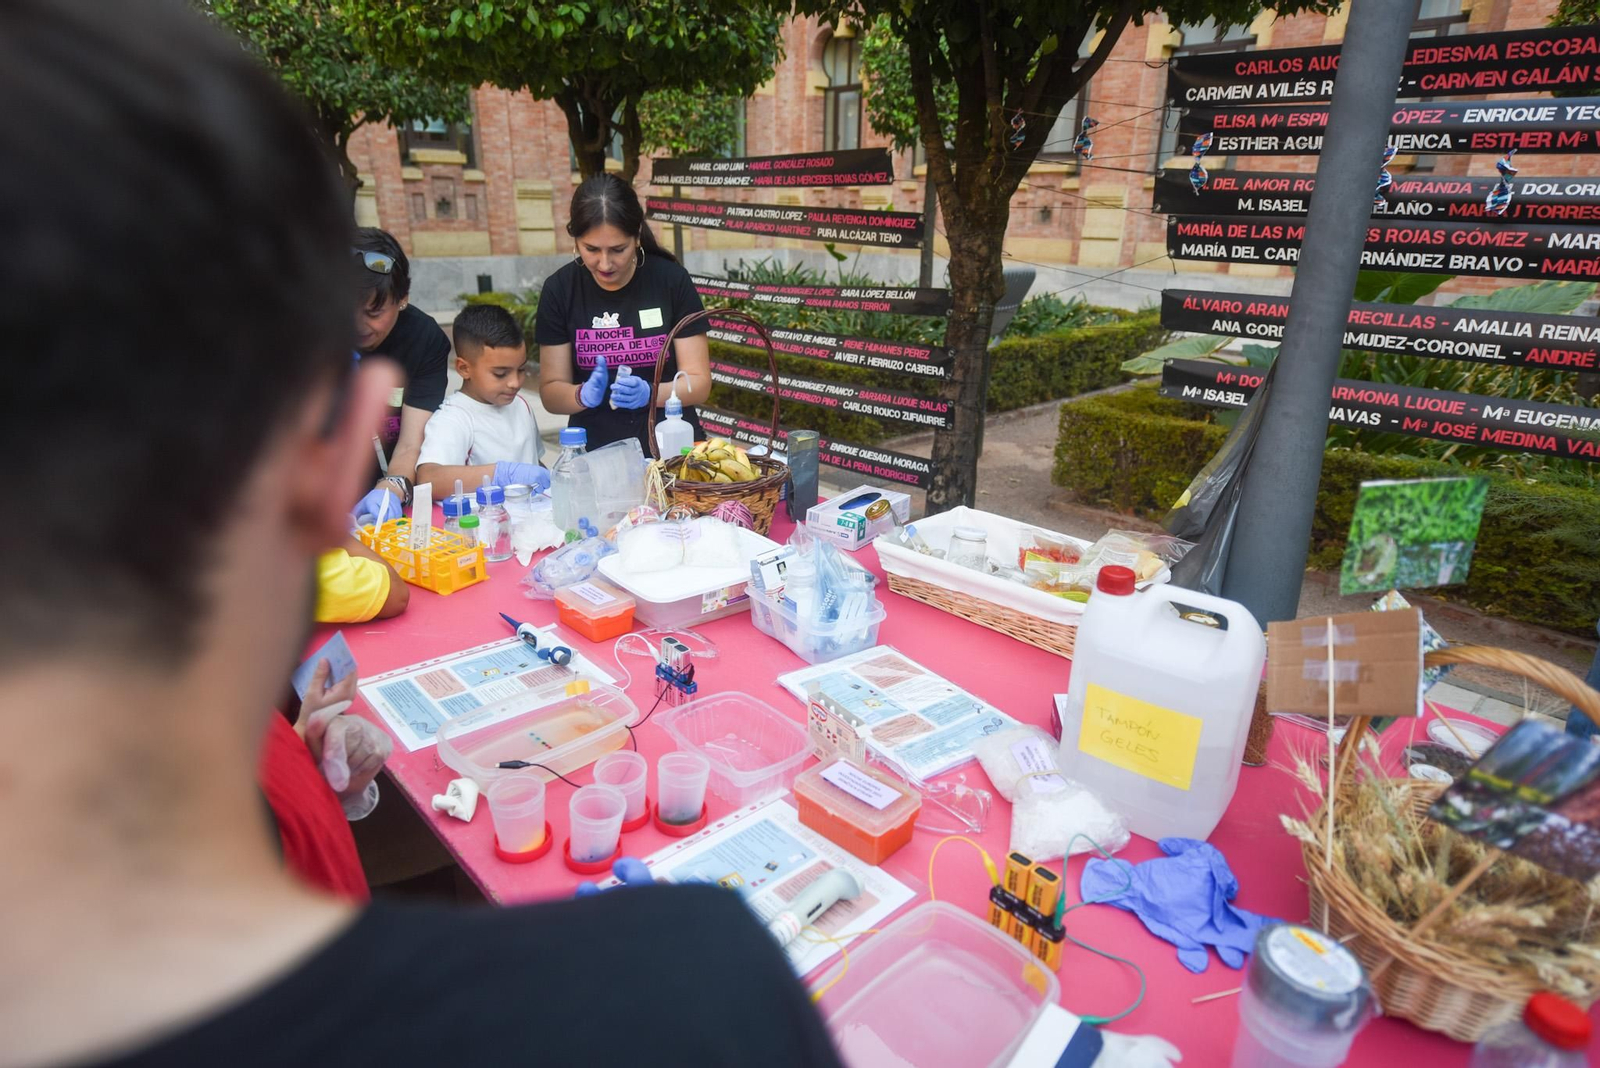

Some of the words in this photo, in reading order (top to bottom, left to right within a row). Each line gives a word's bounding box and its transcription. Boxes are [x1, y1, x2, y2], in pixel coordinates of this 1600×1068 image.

[1235, 58, 1303, 76] CARLOS
[1185, 84, 1253, 102] CARMEN
[1256, 78, 1317, 98] AVILÉS
[1420, 69, 1508, 91] CARMEN
[1511, 62, 1590, 86] GALÁN
[1213, 113, 1257, 129] ELISA
[1462, 106, 1558, 123] ENRIQUE
[1218, 136, 1279, 151] ESTHER
[1470, 131, 1553, 149] ESTHER
[689, 162, 712, 171] MANUEL
[713, 162, 729, 171] CANO
[729, 162, 745, 171] LUNA
[748, 162, 772, 171] MANUEL
[805, 157, 835, 168] ROSADO
[774, 175, 783, 185] DE
[783, 175, 796, 185] LAS
[796, 174, 833, 185] MERCEDES
[834, 173, 857, 184] ROJAS
[858, 171, 887, 183] GÓMEZ
[1213, 177, 1239, 191] DEL
[1243, 178, 1290, 192] AMOR
[1389, 181, 1473, 195] MIRANDA
[726, 206, 753, 218] PATRICIA
[754, 208, 780, 219] CASTRO
[807, 211, 831, 223] PAULA
[832, 213, 867, 226] REVENGA
[868, 214, 917, 229] DOMÍNGUEZ
[725, 218, 745, 229] PILAR
[745, 221, 775, 232] APARICIO
[817, 227, 838, 238] PURA
[838, 228, 877, 242] ALCÁZAR
[879, 232, 902, 243] TENO
[1177, 220, 1224, 237] MARÍA
[1227, 224, 1248, 238] DE
[1250, 225, 1283, 239] LAS
[1385, 228, 1446, 245] ROJAS
[1451, 227, 1529, 247] GÓMEZ
[1181, 241, 1227, 258] MARÍA
[1231, 245, 1260, 260] DEL
[1449, 254, 1523, 272] BRAVO
[804, 298, 831, 308] SUSANA
[832, 299, 859, 310] RAMOS
[841, 288, 860, 298] SARA
[861, 287, 885, 299] LÓPEZ
[885, 288, 917, 300] BELLÓN
[1182, 295, 1243, 314] ÁLVARO
[1453, 318, 1533, 338] AMALIA
[1211, 319, 1242, 334] ANA
[577, 342, 626, 353] EUROPEA
[628, 340, 643, 350] DE
[578, 331, 590, 340] LA
[595, 328, 631, 340] NOCHE
[771, 329, 801, 342] GUSTAVO
[801, 333, 813, 343] DE
[812, 334, 838, 347] MIGUEL
[843, 338, 865, 350] IRENE
[865, 341, 903, 356] HUMANES
[804, 345, 831, 359] GÓMEZ
[858, 354, 867, 365] F.
[867, 356, 904, 371] HERRUZO
[716, 362, 738, 375] TORRES
[825, 384, 854, 397] FRANCO
[892, 394, 918, 409] LUQUE
[918, 400, 948, 413] SALAS
[791, 390, 822, 404] HERRUZO
[821, 396, 838, 407] PINO
[843, 400, 873, 414] CARLOS
[873, 405, 901, 419] ROUCO
[1404, 395, 1466, 416] LUQUE
[716, 414, 735, 426] LUQUE
[829, 442, 859, 457] ENRIQUE
[892, 456, 930, 474] MORAGA
[1431, 421, 1479, 440] JOSÉ
[1480, 427, 1558, 451] MEDINA
[735, 431, 748, 441] EVA
[831, 455, 841, 466] DE
[841, 459, 852, 469] LA
[1096, 706, 1161, 740] TAMPÓN
[1100, 729, 1160, 763] GELES
